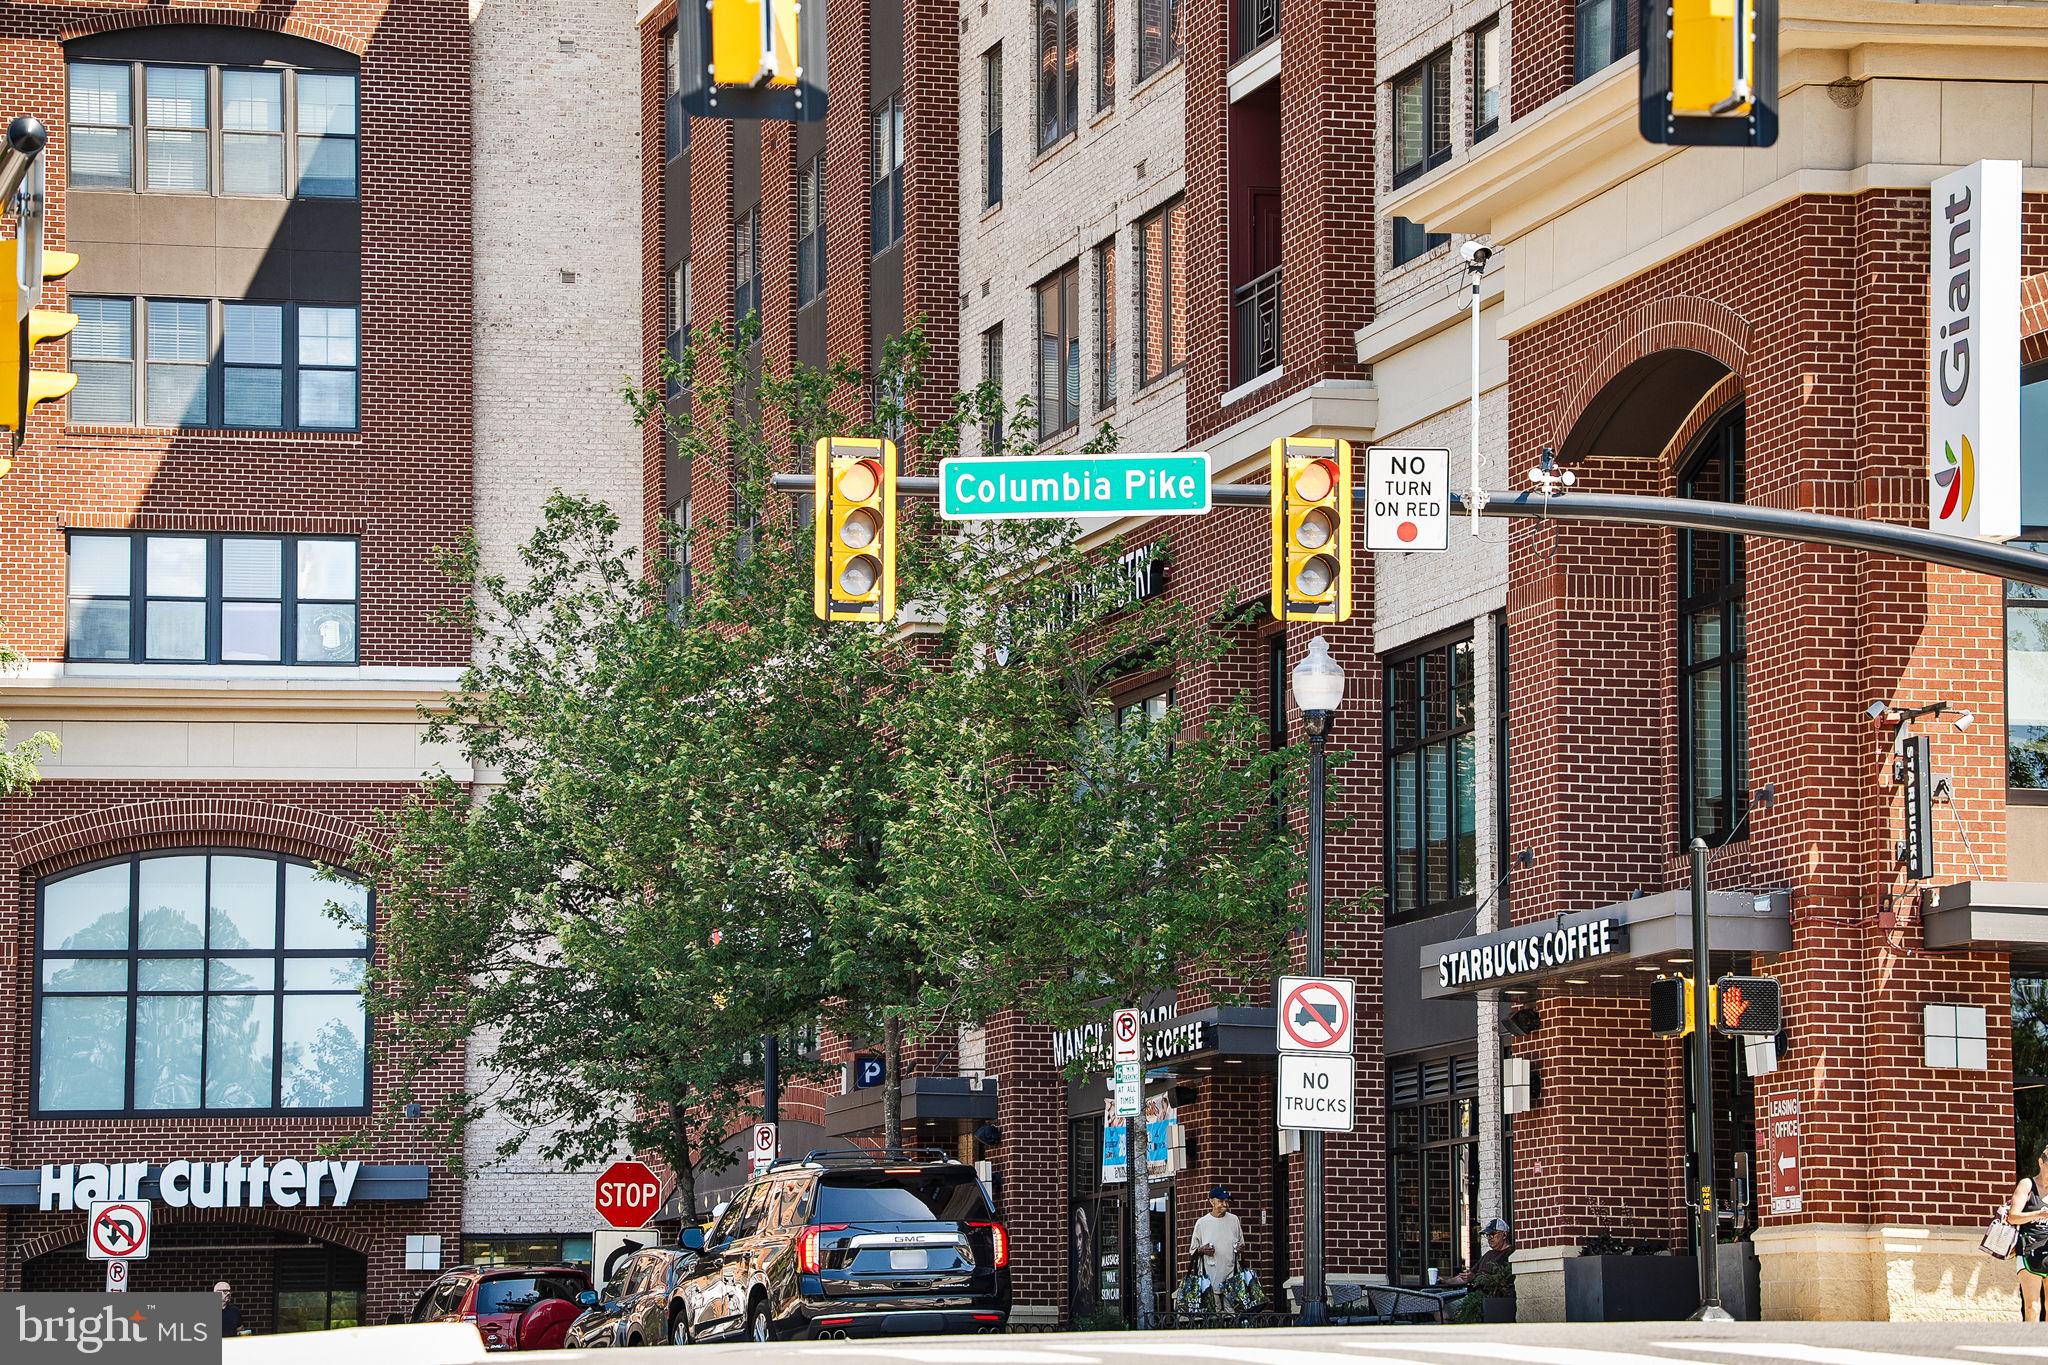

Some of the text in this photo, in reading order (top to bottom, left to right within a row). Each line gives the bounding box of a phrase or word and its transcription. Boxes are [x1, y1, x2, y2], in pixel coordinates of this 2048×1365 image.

[1939, 185, 1972, 407] Giant
[1391, 456, 1425, 475] NO
[955, 469, 1196, 504] Columbia Pike
[1385, 481, 1431, 495] TURN
[1375, 502, 1440, 516] ON RED
[1906, 745, 1918, 871] STARBUCKS
[1439, 919, 1611, 988] STARBUCKS COFFEE
[1156, 1021, 1203, 1059] COFFEE
[1127, 1085, 1136, 1093] ALL
[1303, 1072, 1329, 1090] NO
[1120, 1096, 1135, 1104] TIMES
[1285, 1096, 1347, 1113] TRUCKS
[1770, 1099, 1797, 1117] LEASING
[1775, 1120, 1798, 1138] OFFICE
[40, 1160, 148, 1211] Hair
[599, 1182, 657, 1208] STOP
[894, 1235, 926, 1243] GMC
